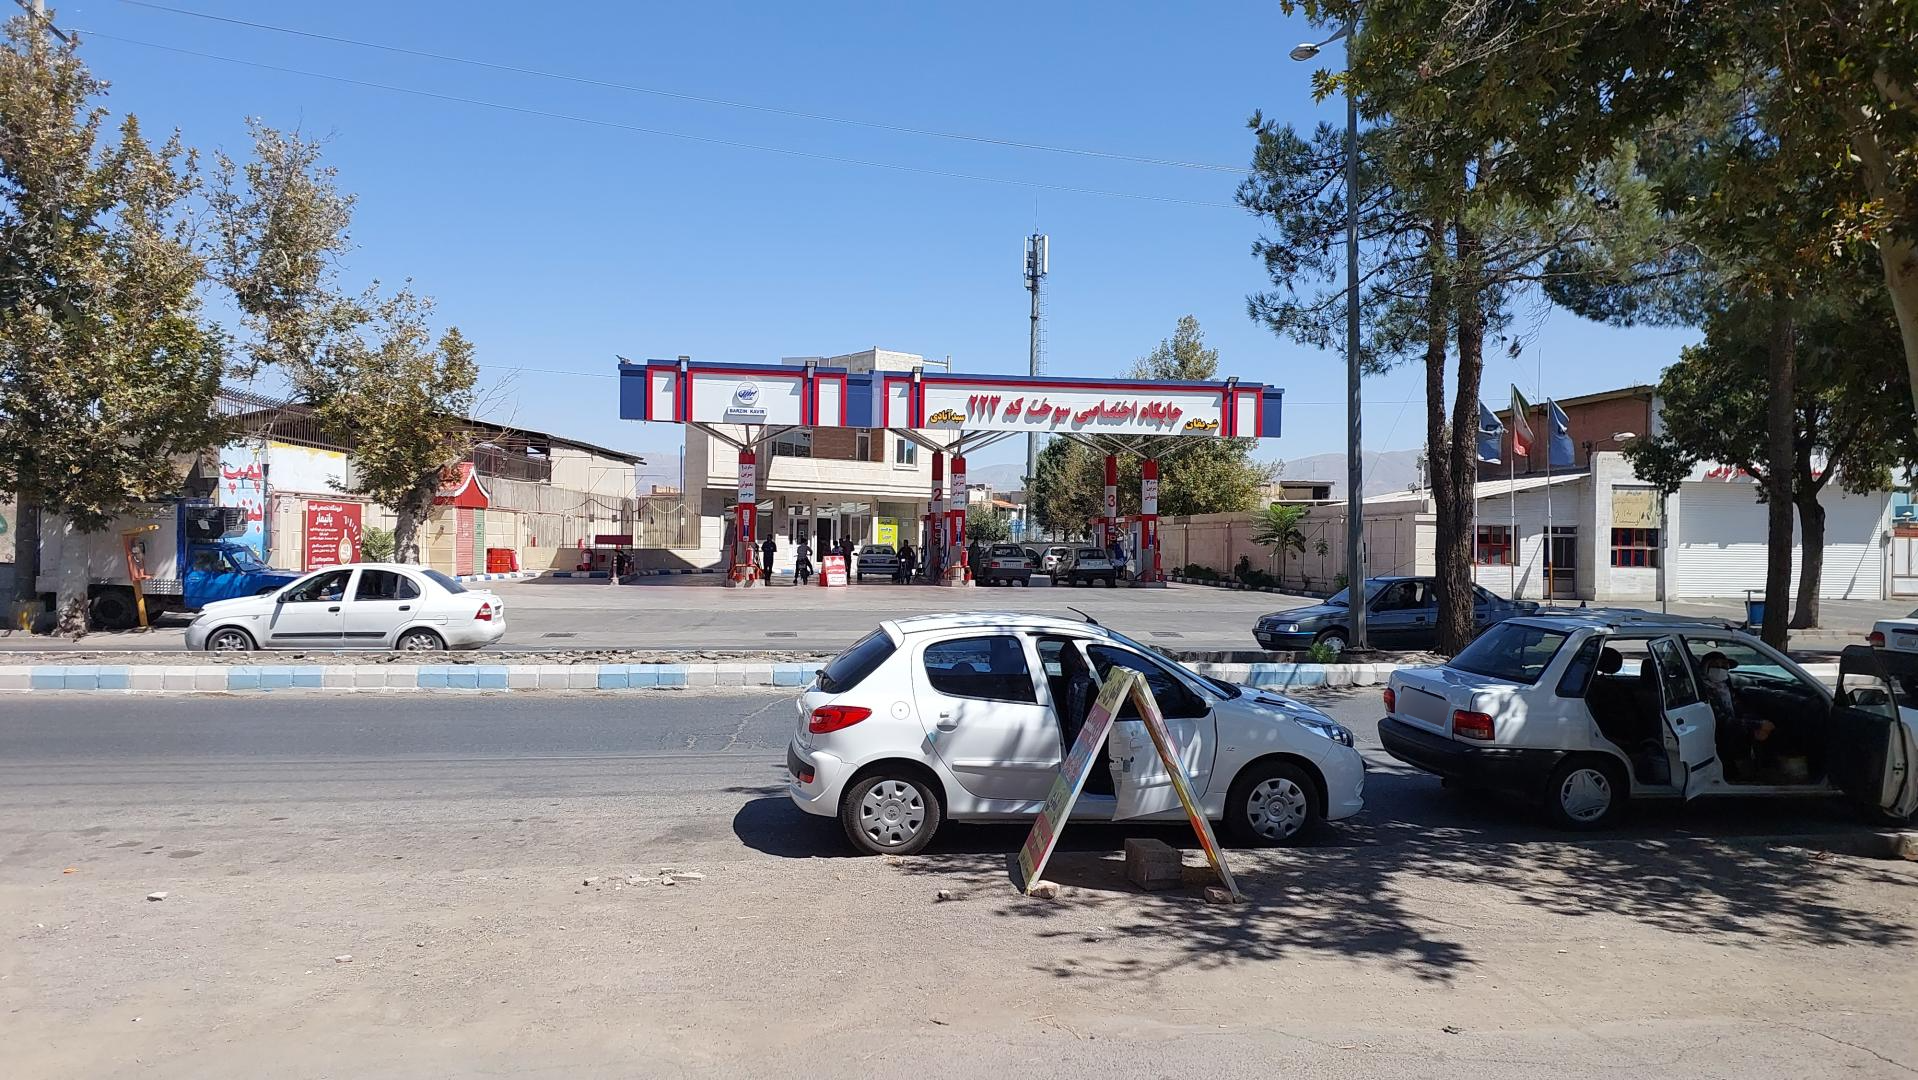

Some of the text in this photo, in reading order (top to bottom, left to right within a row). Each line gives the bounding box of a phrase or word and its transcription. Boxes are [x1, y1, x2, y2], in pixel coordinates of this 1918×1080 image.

[968, 394, 1183, 425] جایگاه اختصاصی سوخت کد ۲۲۳
[223, 463, 262, 495] پمپ
[934, 488, 942, 501] 2
[1107, 494, 1116, 508] 3
